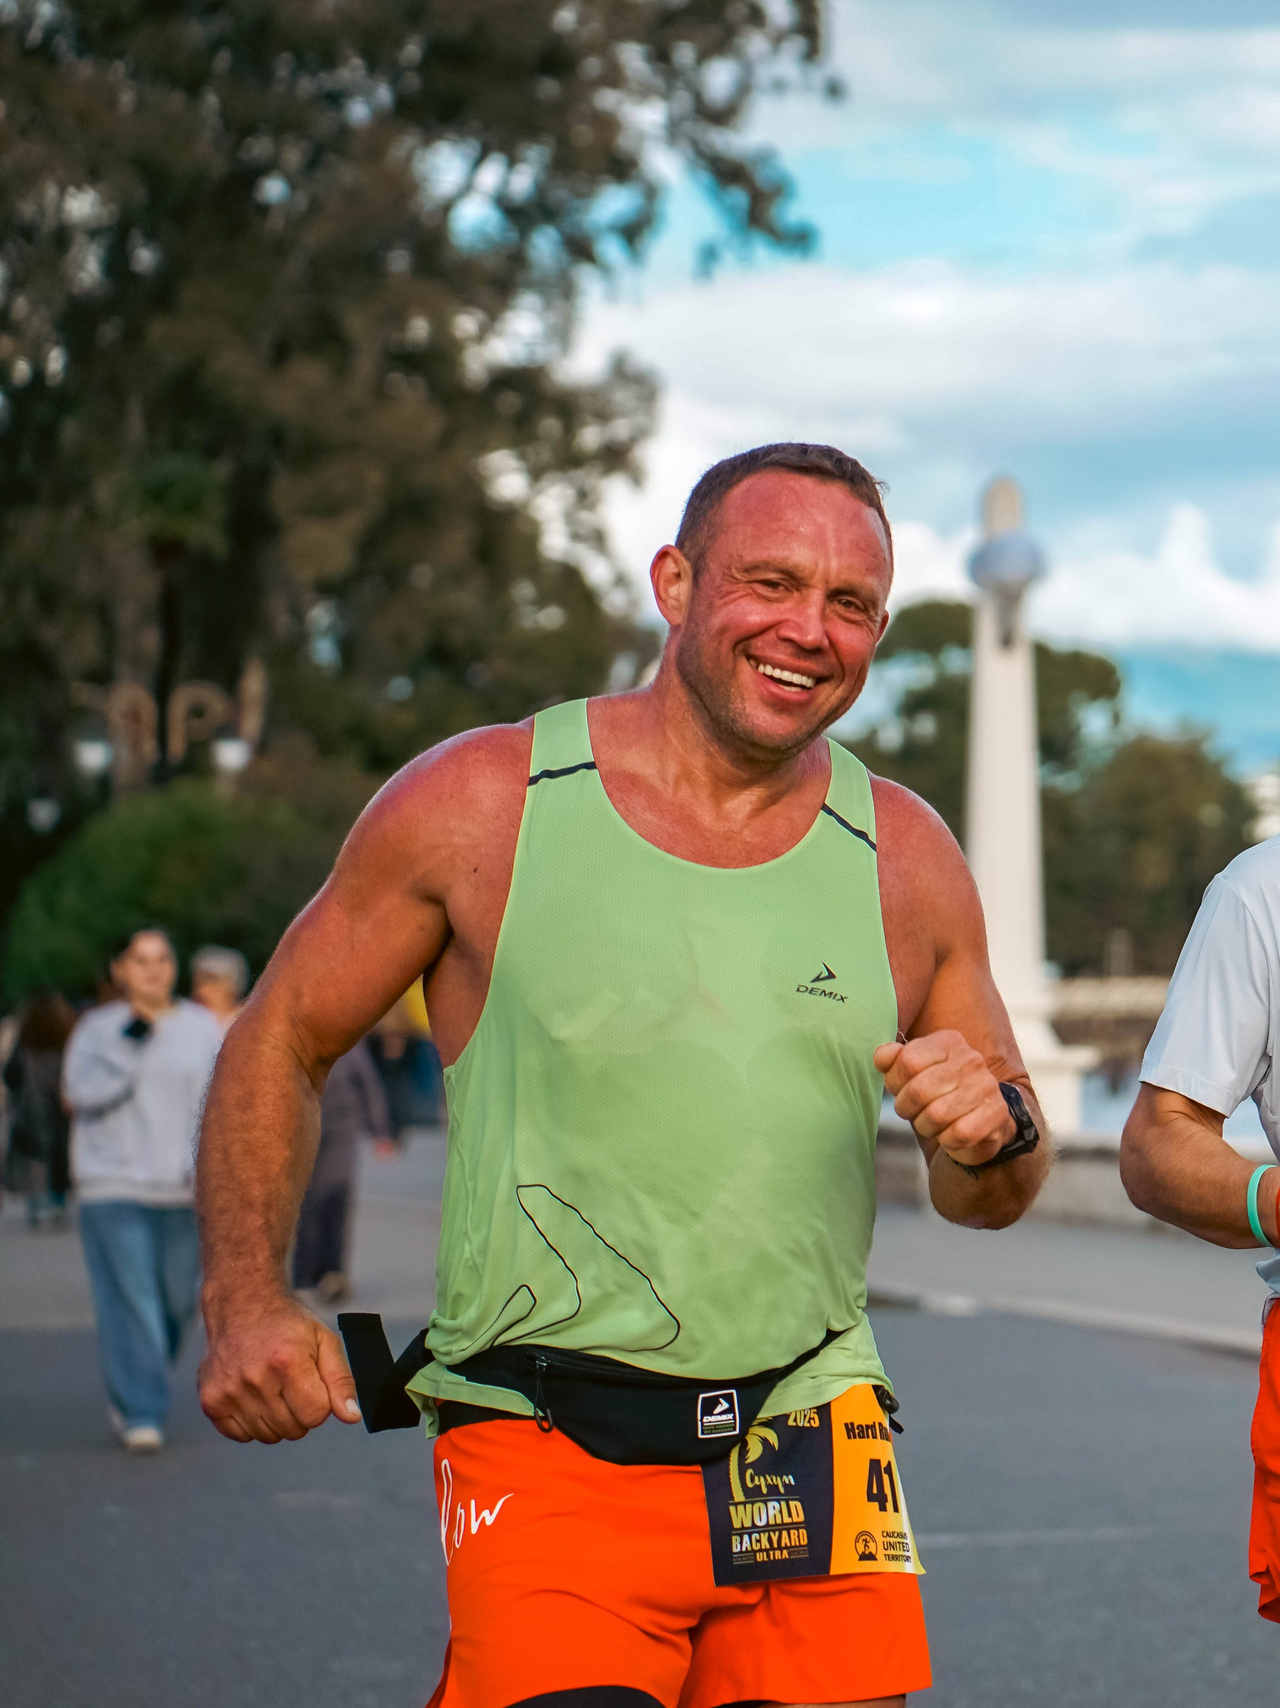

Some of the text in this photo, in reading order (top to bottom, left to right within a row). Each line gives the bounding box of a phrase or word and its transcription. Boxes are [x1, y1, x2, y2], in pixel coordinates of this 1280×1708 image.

[796, 984, 849, 1004] DEMIX
[787, 1408, 820, 1428] 2025
[844, 1421, 878, 1440] Hard
[866, 1458, 900, 1514] 41
[729, 1500, 805, 1529] WORLD
[731, 1528, 808, 1553] BACKYARD
[882, 1541, 910, 1552] UNITED
[756, 1549, 789, 1562] ULTRA
